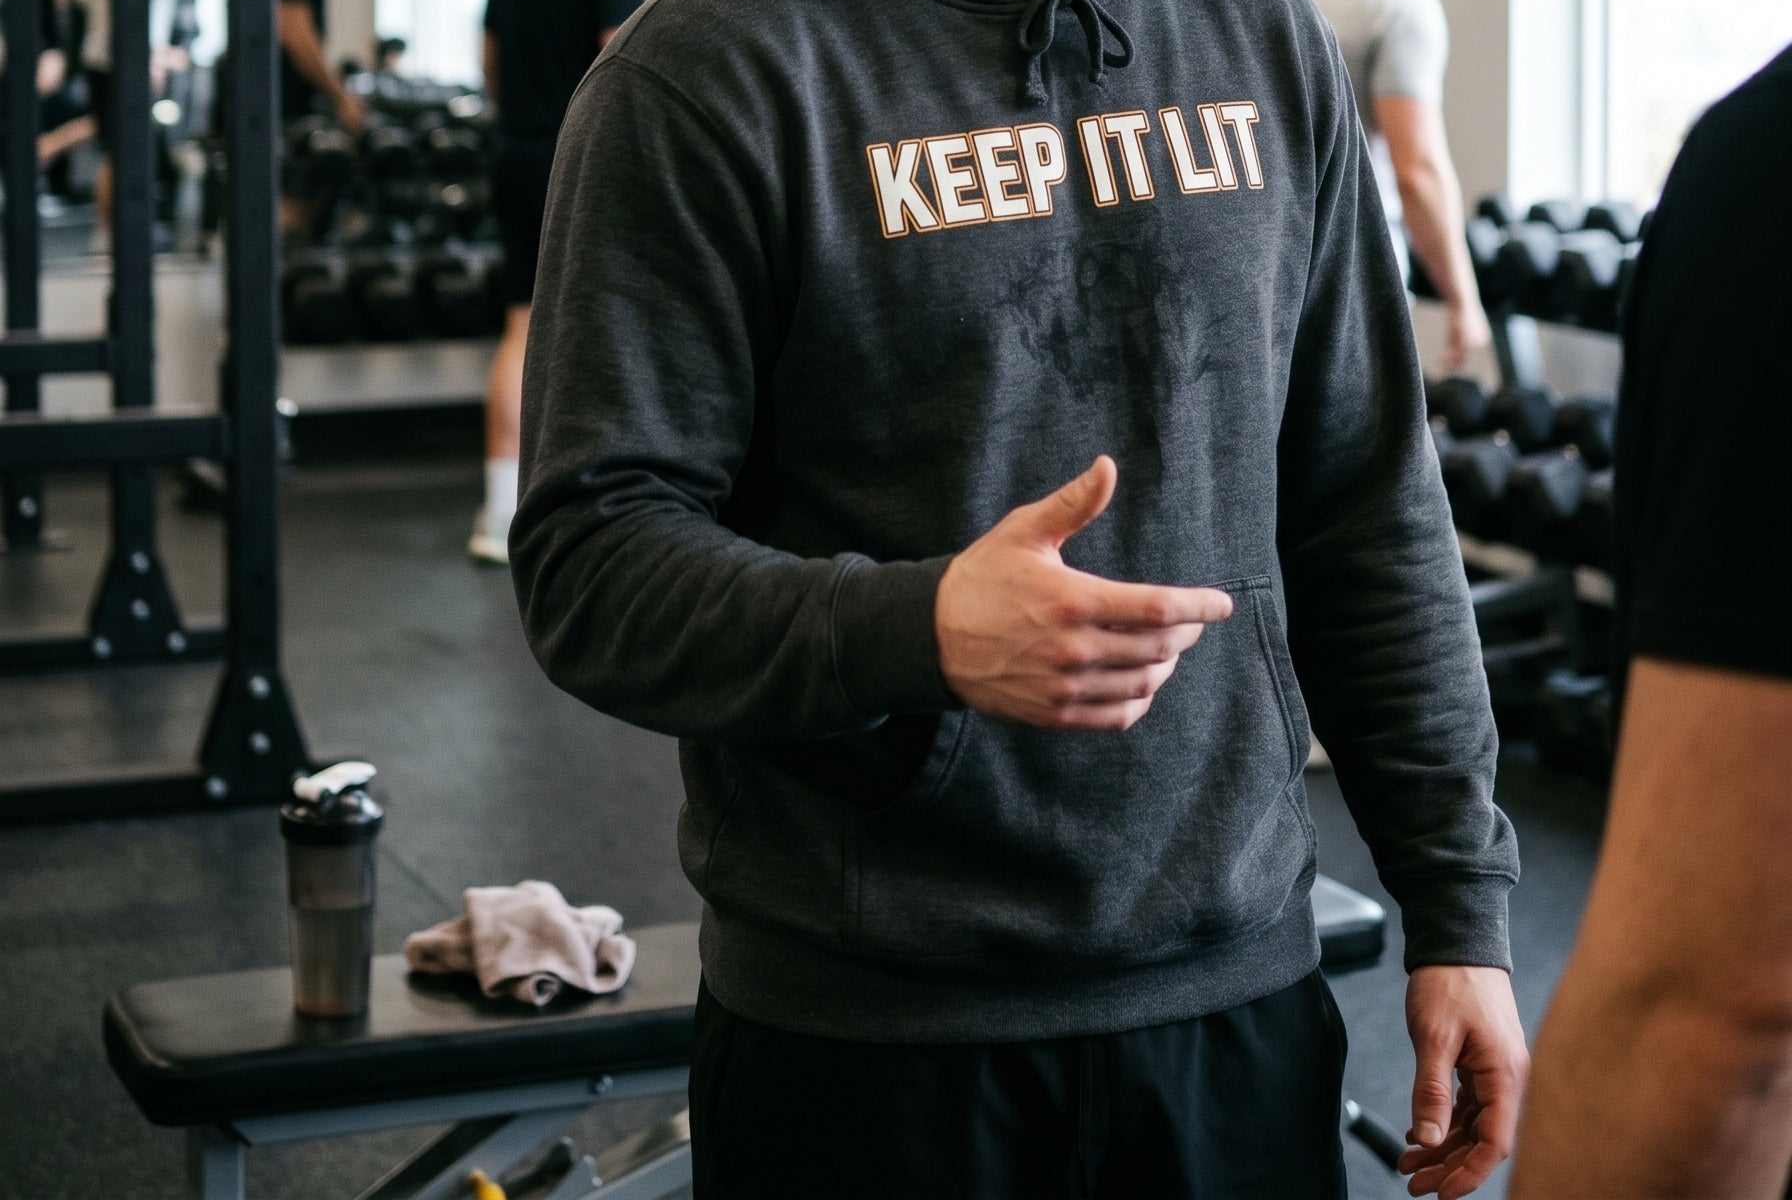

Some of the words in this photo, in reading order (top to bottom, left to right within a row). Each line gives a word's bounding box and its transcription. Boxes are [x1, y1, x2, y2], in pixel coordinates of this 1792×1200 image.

[866, 123, 1067, 239] KEEP
[1077, 110, 1155, 207] IT
[1158, 101, 1264, 194] LIT
